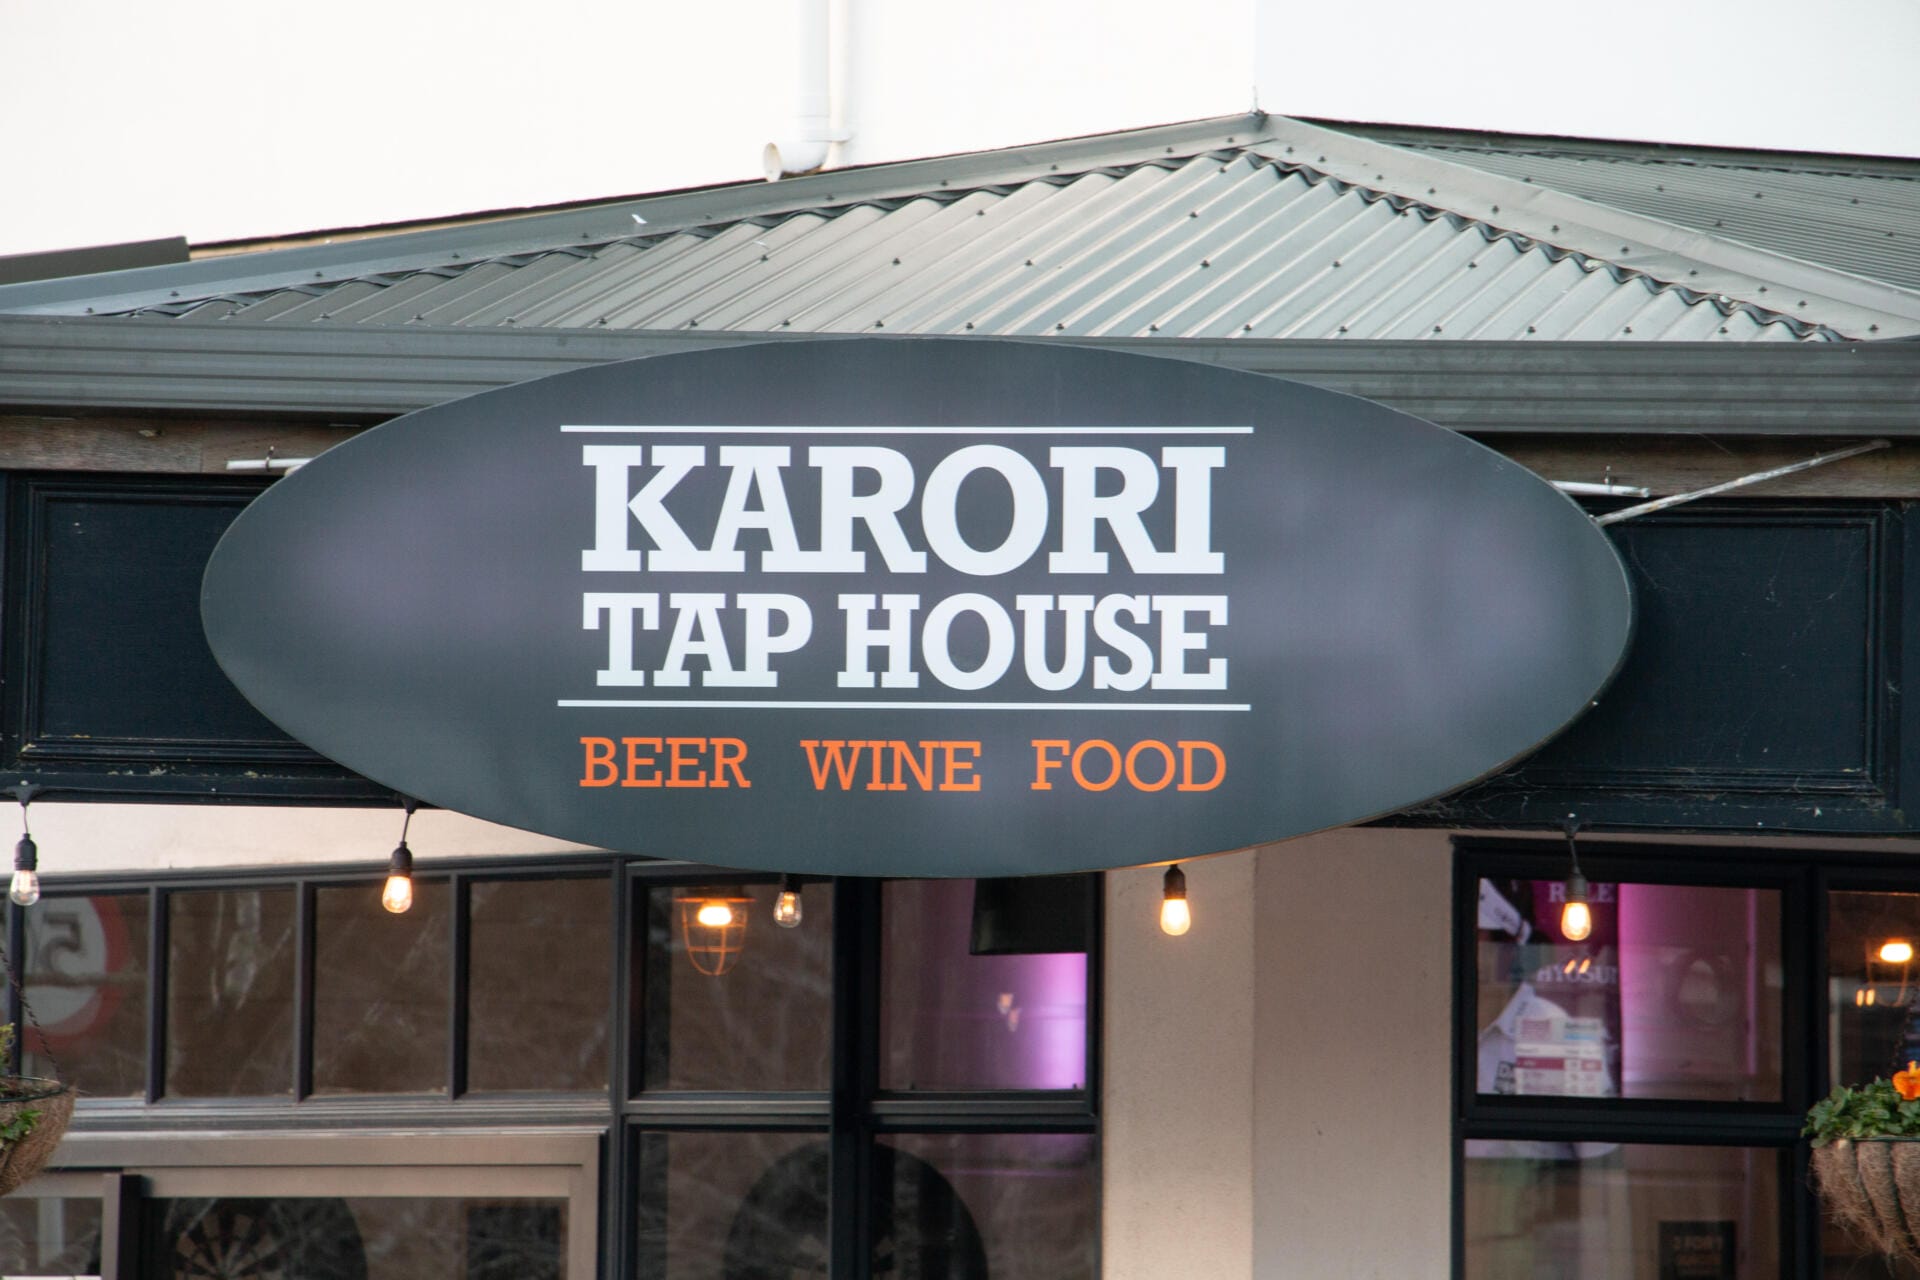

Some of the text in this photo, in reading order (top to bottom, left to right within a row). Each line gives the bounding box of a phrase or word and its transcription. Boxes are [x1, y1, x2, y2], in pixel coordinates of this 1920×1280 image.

[581, 444, 1226, 576] KARORI
[582, 592, 1228, 692] TAP HOUSE
[579, 736, 1227, 793] BEER WINE FOOD
[1549, 882, 1615, 903] RLE
